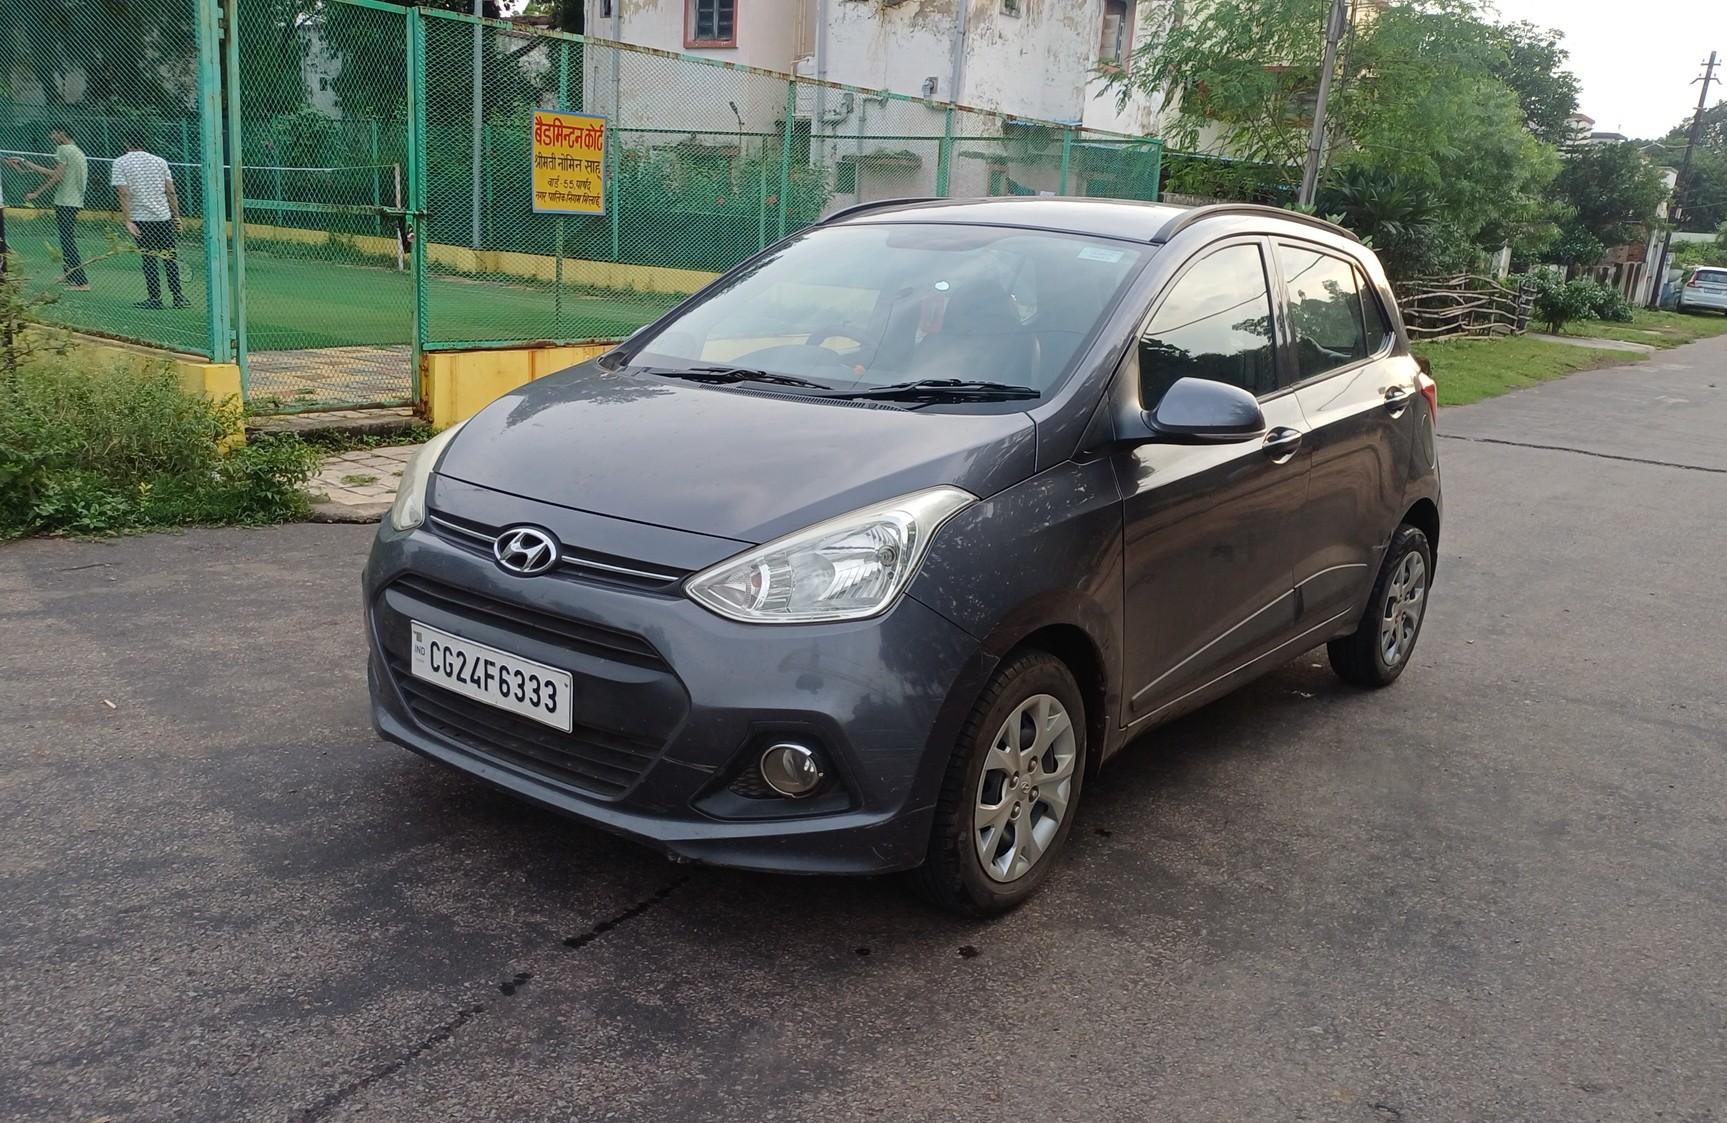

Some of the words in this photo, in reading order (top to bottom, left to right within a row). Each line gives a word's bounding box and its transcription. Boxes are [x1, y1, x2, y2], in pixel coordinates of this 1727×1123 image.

[584, 123, 604, 151] कोर्ट
[534, 151, 557, 170] श्रीमती
[414, 645, 426, 656] IND
[430, 640, 558, 714] CG24F6333
